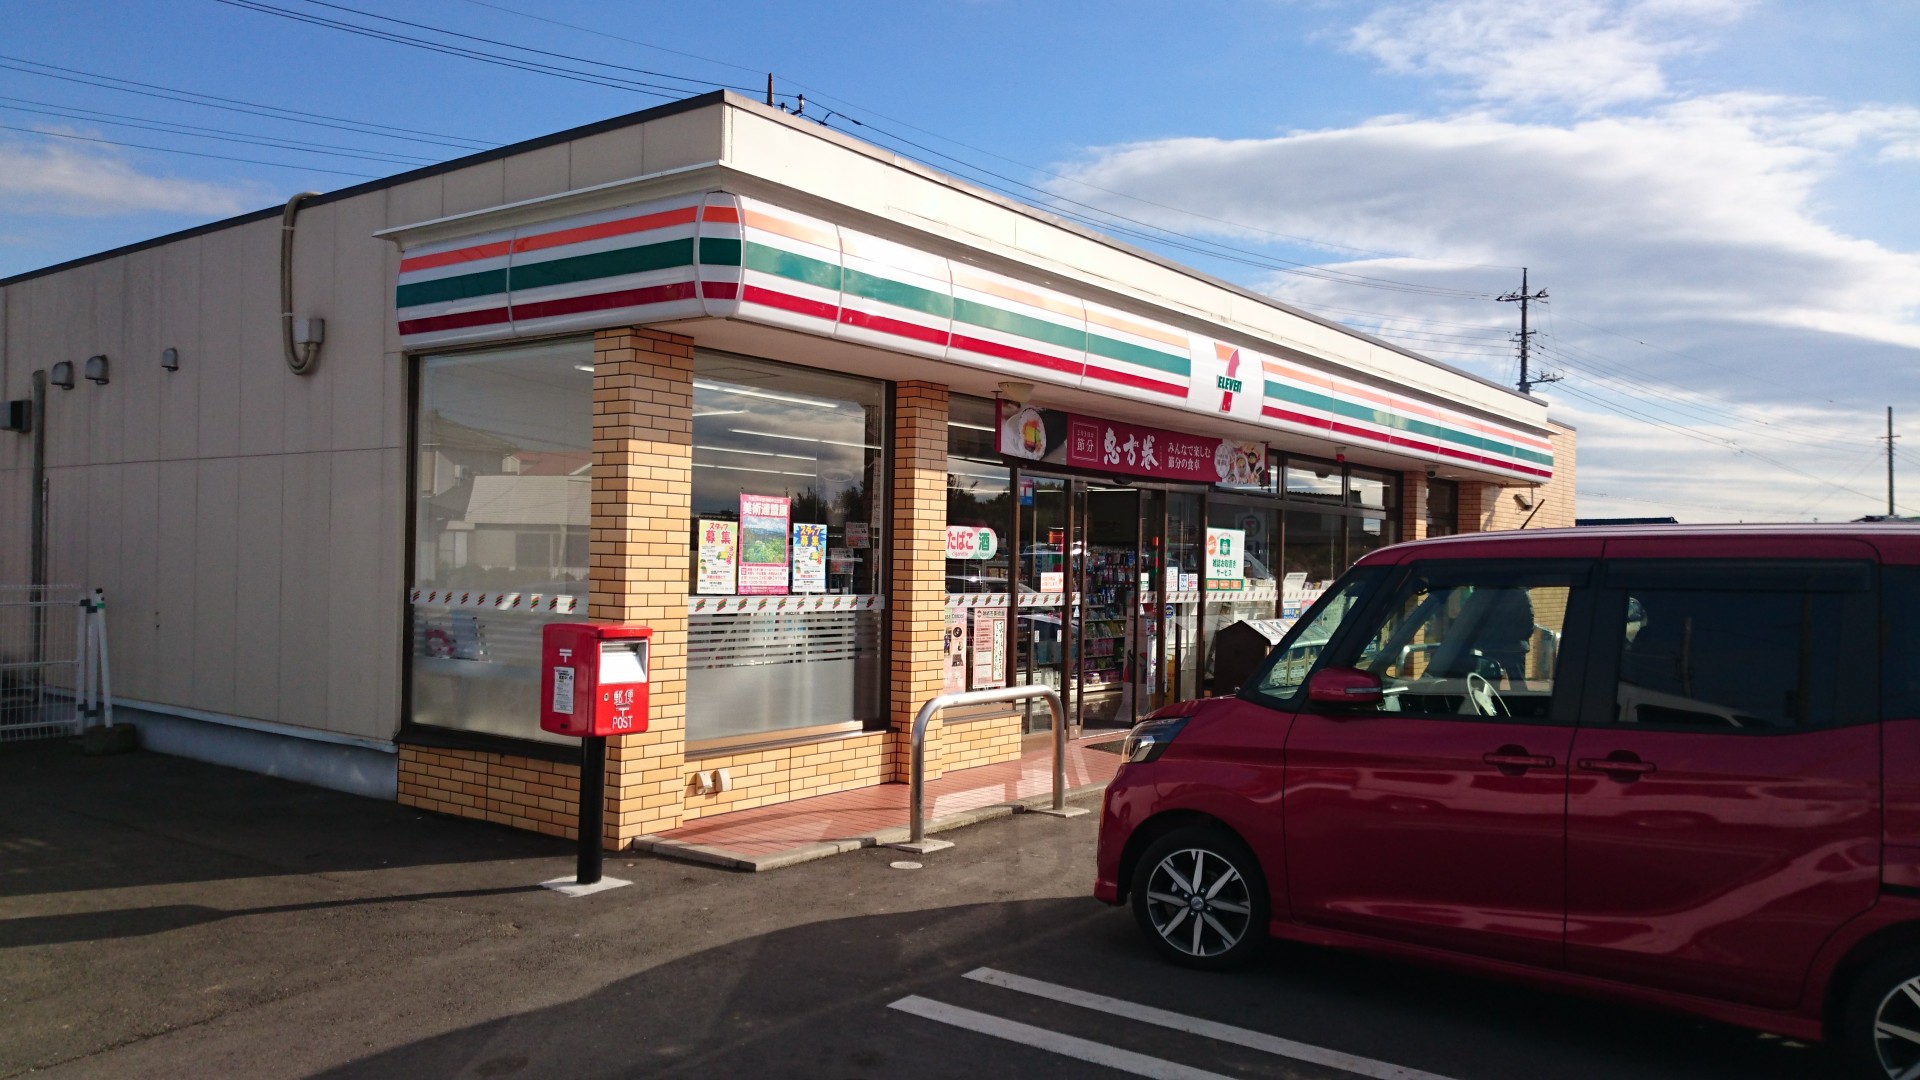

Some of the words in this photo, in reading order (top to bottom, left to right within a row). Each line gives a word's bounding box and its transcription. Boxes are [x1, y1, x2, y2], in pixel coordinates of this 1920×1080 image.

[1076, 438, 1095, 454] 節分
[1103, 426, 1160, 471] 恵方巻
[1168, 442, 1211, 458] みんなで楽しむ
[1168, 456, 1201, 471] 節分の食卓
[742, 501, 788, 517] 美術連盟展
[709, 522, 728, 531] スタッフ
[800, 525, 820, 536] スタッフ
[705, 530, 731, 545] 募集
[800, 535, 820, 547] 募集
[947, 531, 974, 551] たばこ
[978, 532, 990, 551] 酒
[1216, 569, 1232, 577] サービス
[613, 689, 634, 705] 郵便
[612, 716, 633, 730] POST
